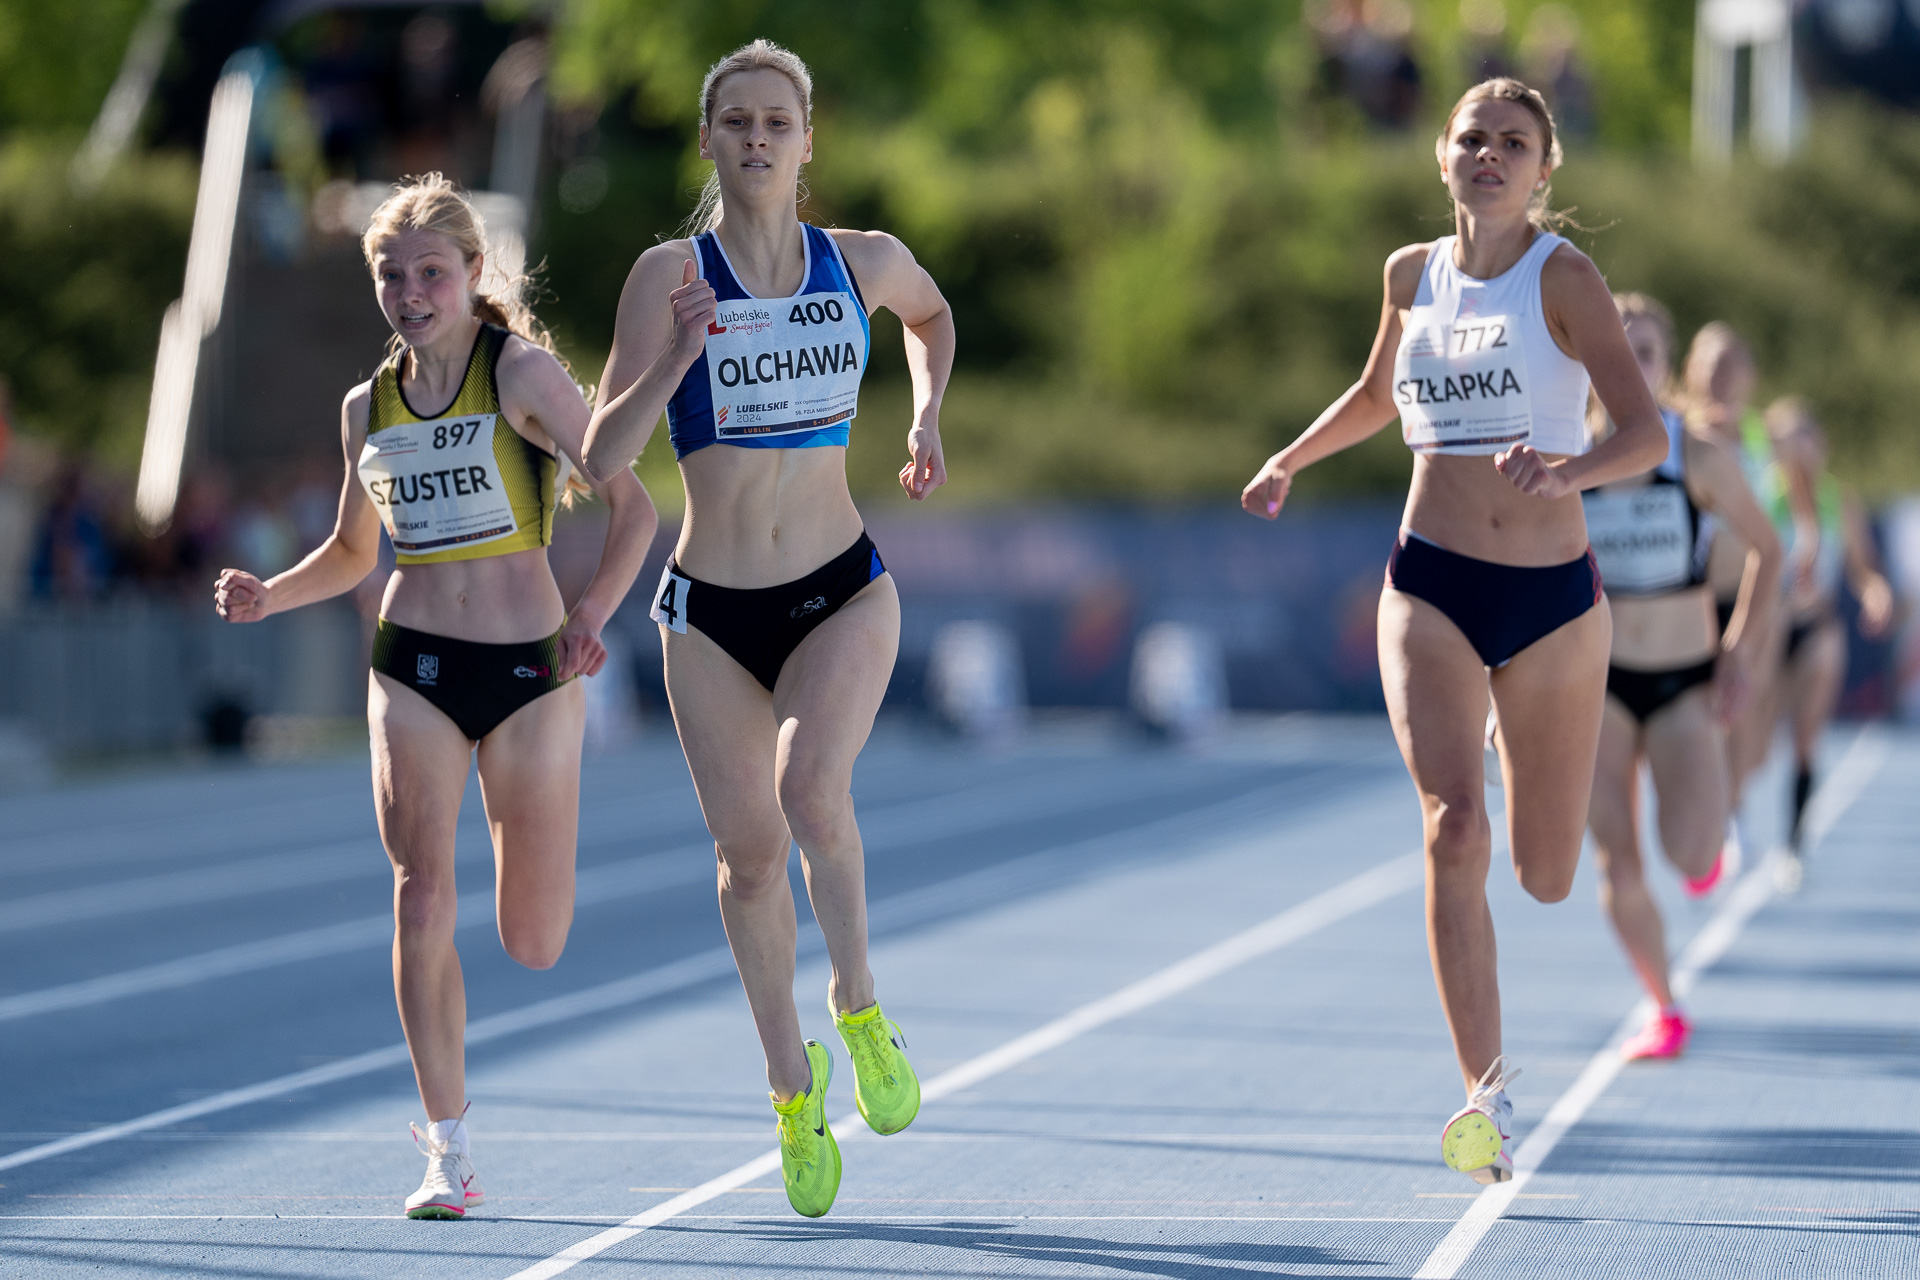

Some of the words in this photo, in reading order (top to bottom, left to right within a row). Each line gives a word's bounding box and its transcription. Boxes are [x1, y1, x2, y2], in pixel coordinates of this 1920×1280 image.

[720, 309, 770, 324] lubelskie
[788, 299, 844, 327] 400
[1453, 324, 1508, 353] 772
[718, 341, 858, 388] OLCHAWA
[1397, 366, 1522, 405] SZŁAPKA
[736, 400, 789, 414] LUBELSKIE
[736, 414, 762, 423] 2024
[432, 420, 481, 450] 897
[743, 426, 771, 435] LUBLIN
[369, 465, 493, 506] SZUSTER
[659, 578, 678, 626] 4
